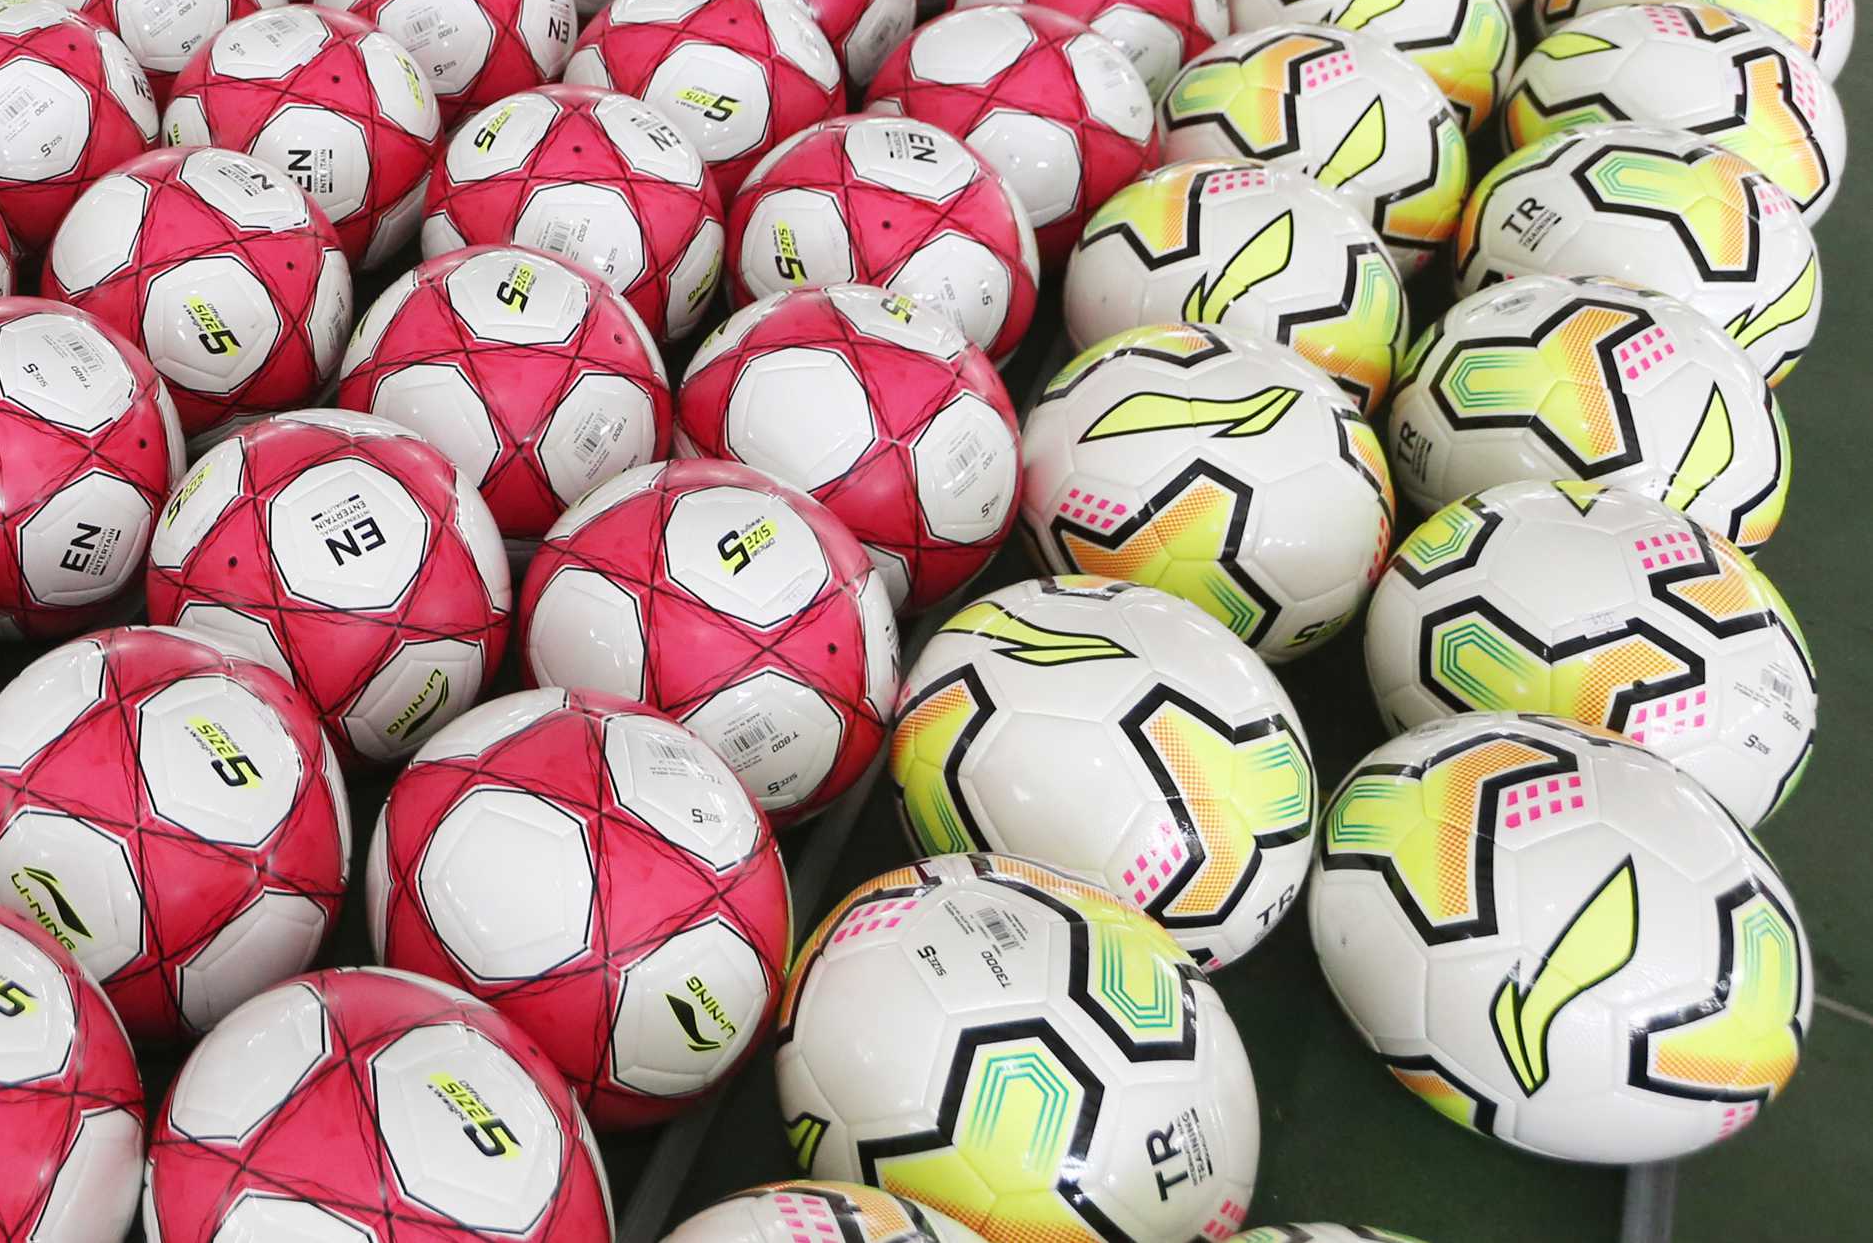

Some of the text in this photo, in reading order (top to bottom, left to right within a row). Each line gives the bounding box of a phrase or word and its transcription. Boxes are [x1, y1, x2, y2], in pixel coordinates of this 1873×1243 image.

[548, 17, 570, 45] EN
[704, 95, 742, 122] 5
[475, 128, 495, 152] 5
[909, 132, 938, 164] EN
[288, 149, 311, 193] EN
[1501, 196, 1545, 236] TR
[497, 267, 531, 314] SIZE 5
[775, 255, 808, 285] 5
[193, 304, 241, 354] SIZE 5
[1399, 420, 1418, 464] TR
[314, 500, 368, 532] ENTERTAIN
[60, 522, 102, 572] EN
[90, 528, 116, 575] ENTERTAIN
[324, 517, 387, 566] EN
[717, 525, 772, 575] SIZE 5
[385, 669, 443, 735] LI-NING
[196, 723, 263, 786] SIZE 5
[11, 872, 77, 952] LI-NING
[1256, 884, 1296, 928] TR
[981, 950, 1012, 988] T3000
[686, 976, 738, 1041] LI-NING
[442, 1082, 522, 1157] SIZE 5
[1146, 1121, 1188, 1201] TR
